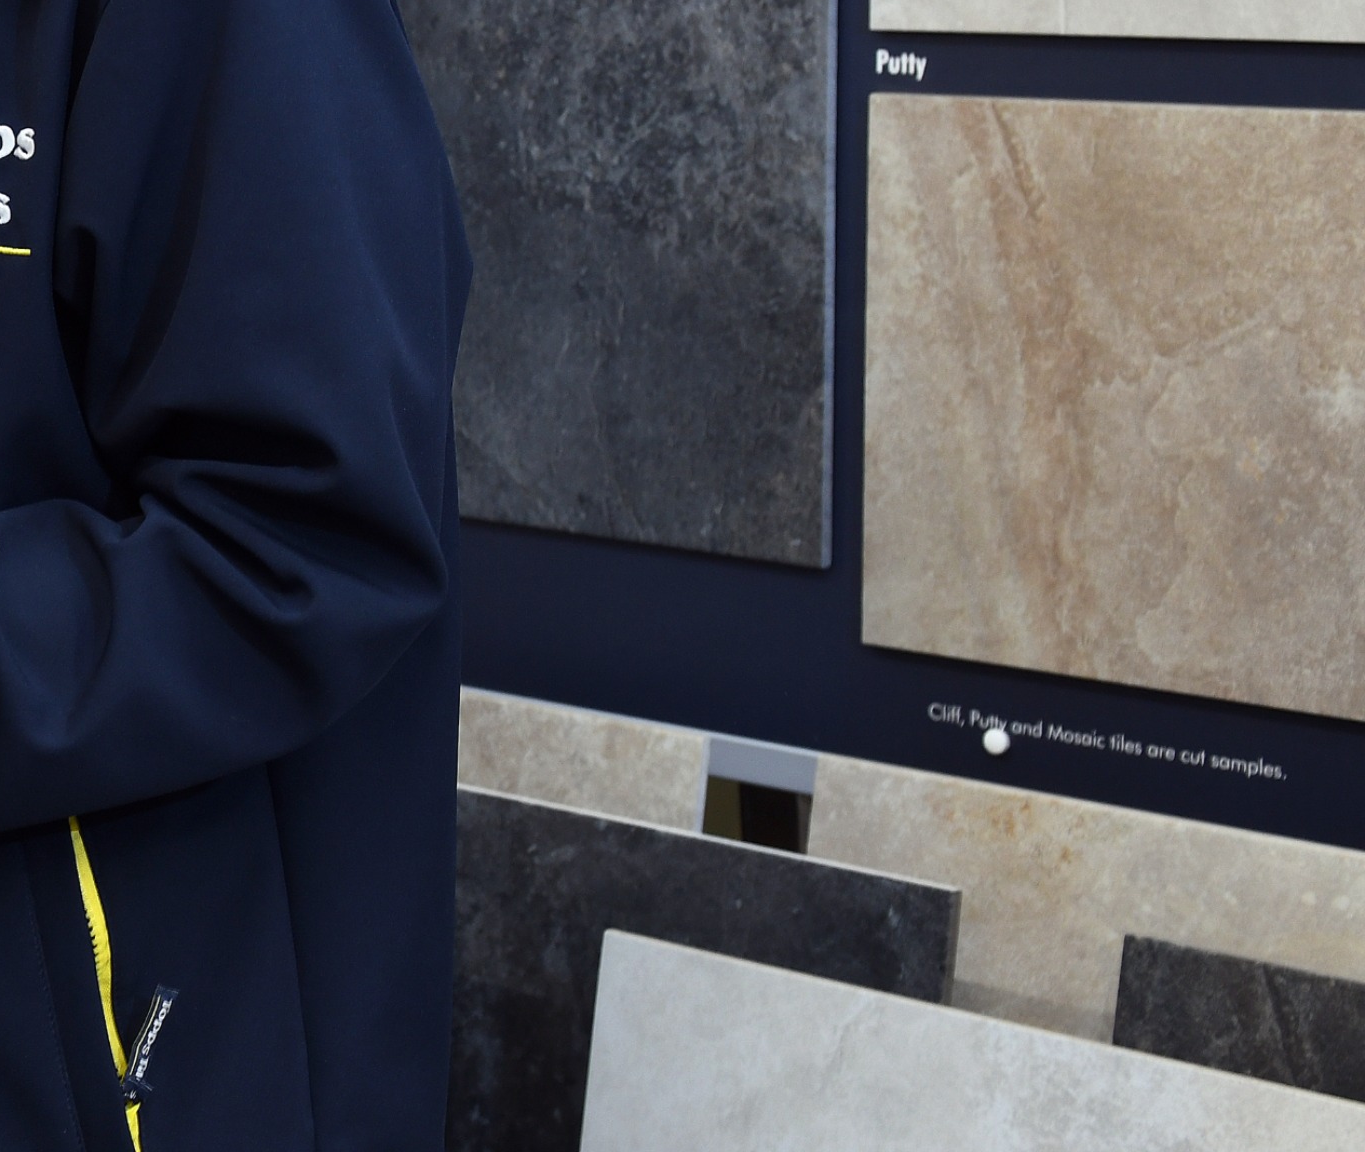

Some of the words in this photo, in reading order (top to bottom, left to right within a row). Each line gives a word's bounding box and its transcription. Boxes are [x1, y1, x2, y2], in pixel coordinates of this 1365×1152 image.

[875, 48, 927, 82] Putty
[928, 702, 965, 727] Cliff,
[1011, 720, 1043, 739] and
[1047, 723, 1105, 749] Mosaic
[1109, 733, 1142, 757] tiles
[1147, 743, 1176, 761] are
[1180, 749, 1206, 767] cut
